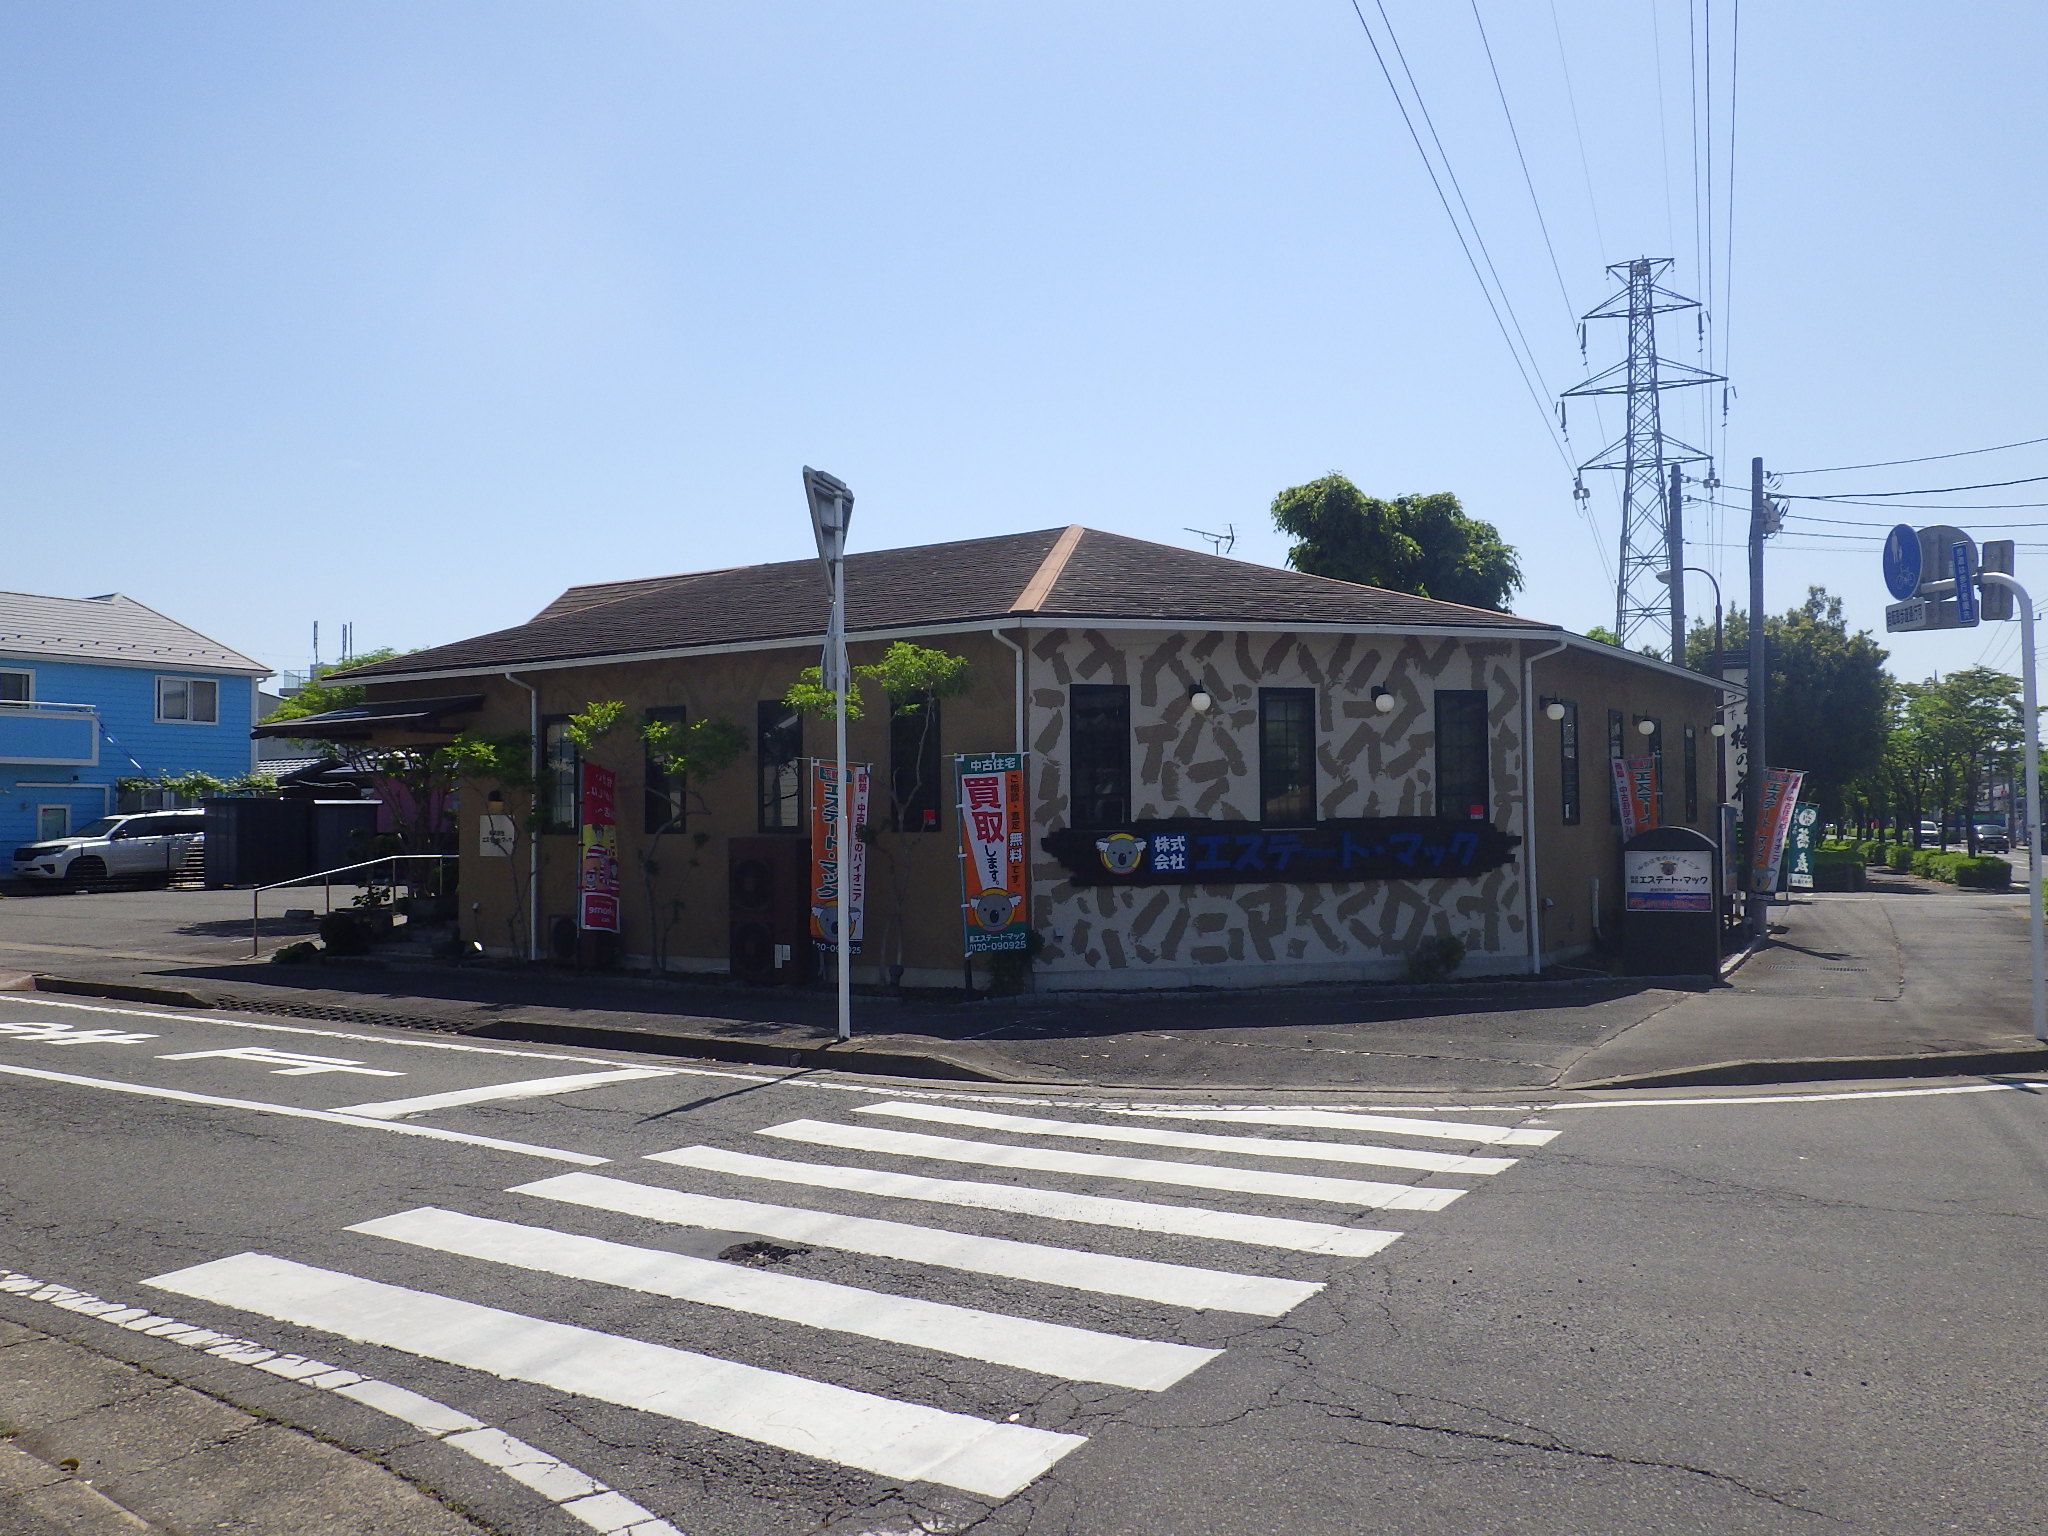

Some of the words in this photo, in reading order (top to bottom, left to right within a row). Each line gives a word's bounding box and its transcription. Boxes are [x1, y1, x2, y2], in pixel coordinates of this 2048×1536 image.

[970, 757, 1016, 772] 中古住宅
[1154, 836, 1185, 852] 株式
[1196, 832, 1480, 871] エステート・マック
[1154, 854, 1185, 870] 会社
[969, 941, 1027, 952] 0120-090925
